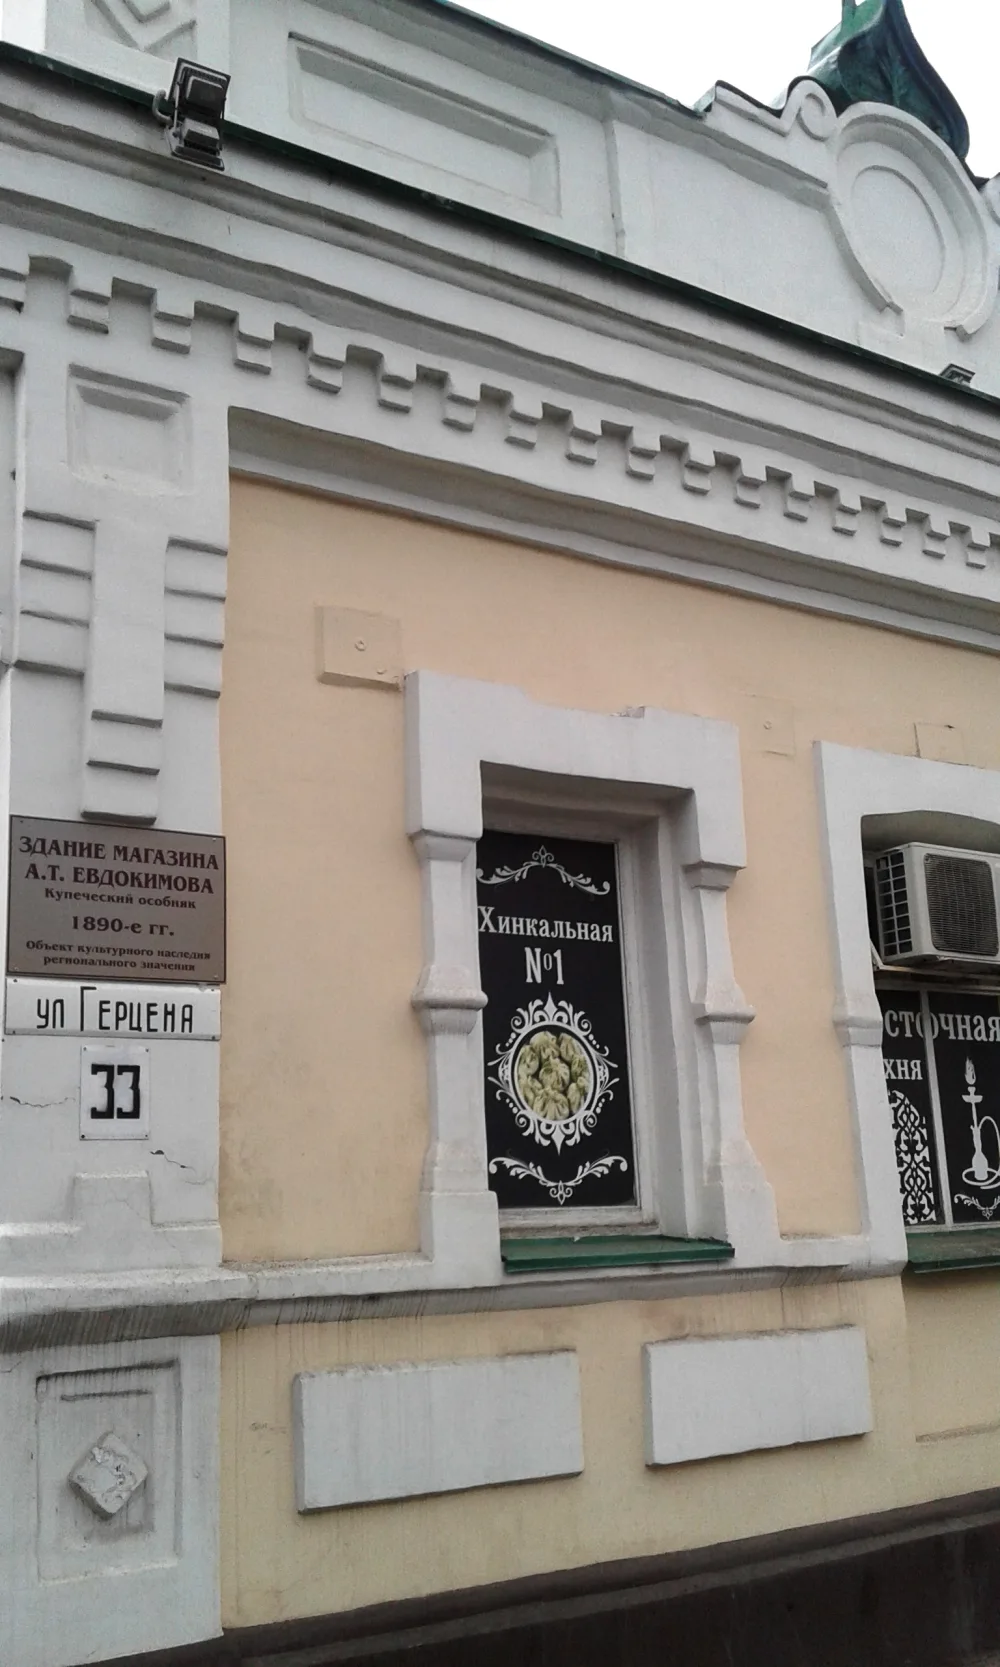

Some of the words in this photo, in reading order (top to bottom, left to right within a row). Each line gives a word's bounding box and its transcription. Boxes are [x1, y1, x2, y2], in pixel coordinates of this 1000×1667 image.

[19, 836, 107, 860] ЗДАНИЕ
[113, 844, 219, 870] МАГАЗИНА
[24, 863, 65, 882] А.Т.
[73, 867, 214, 894] ЕВДОКИМОВА
[45, 888, 134, 905] Купеческий
[138, 895, 197, 910] особняк
[72, 916, 142, 934] 1890-е
[149, 924, 175, 937] гг.
[477, 905, 613, 943] Хинкальная
[26, 940, 73, 952] Объект
[77, 944, 154, 957] культурного
[157, 949, 211, 960] наследия
[43, 956, 137, 969] регионального
[140, 960, 196, 972] значения
[90, 1063, 141, 1120] 33
